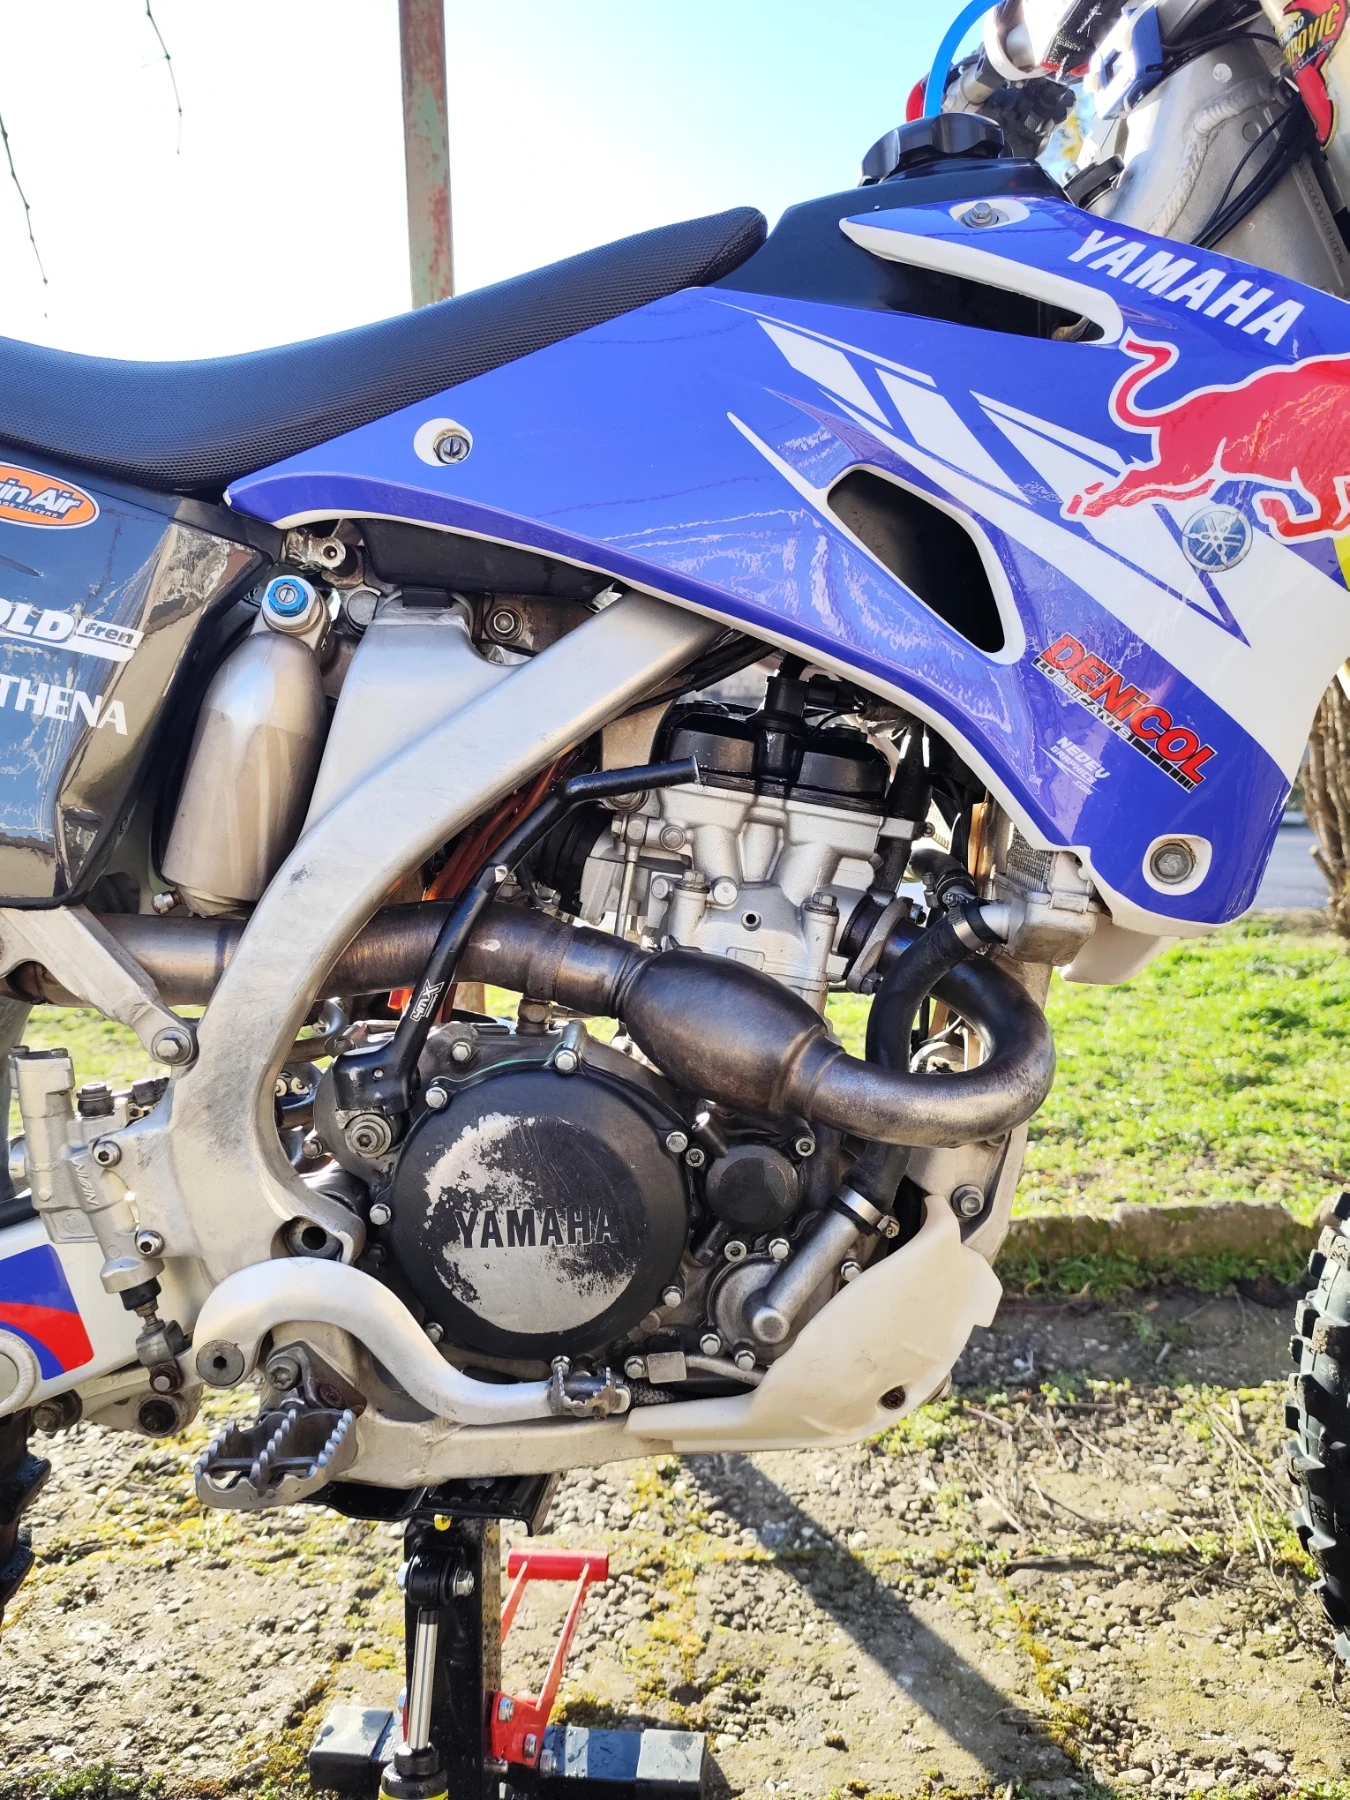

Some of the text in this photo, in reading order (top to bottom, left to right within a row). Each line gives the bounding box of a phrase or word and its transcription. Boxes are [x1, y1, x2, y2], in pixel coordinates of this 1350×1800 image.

[1066, 229, 1305, 346] YAMAHA
[18, 504, 59, 519] FILTERS
[28, 487, 81, 514] Air
[1035, 659, 1132, 740] LUBRICANTS
[1049, 747, 1098, 785] GRAPHICS
[1056, 737, 1111, 779] NEDEV
[453, 1205, 619, 1249] YAMAHA
